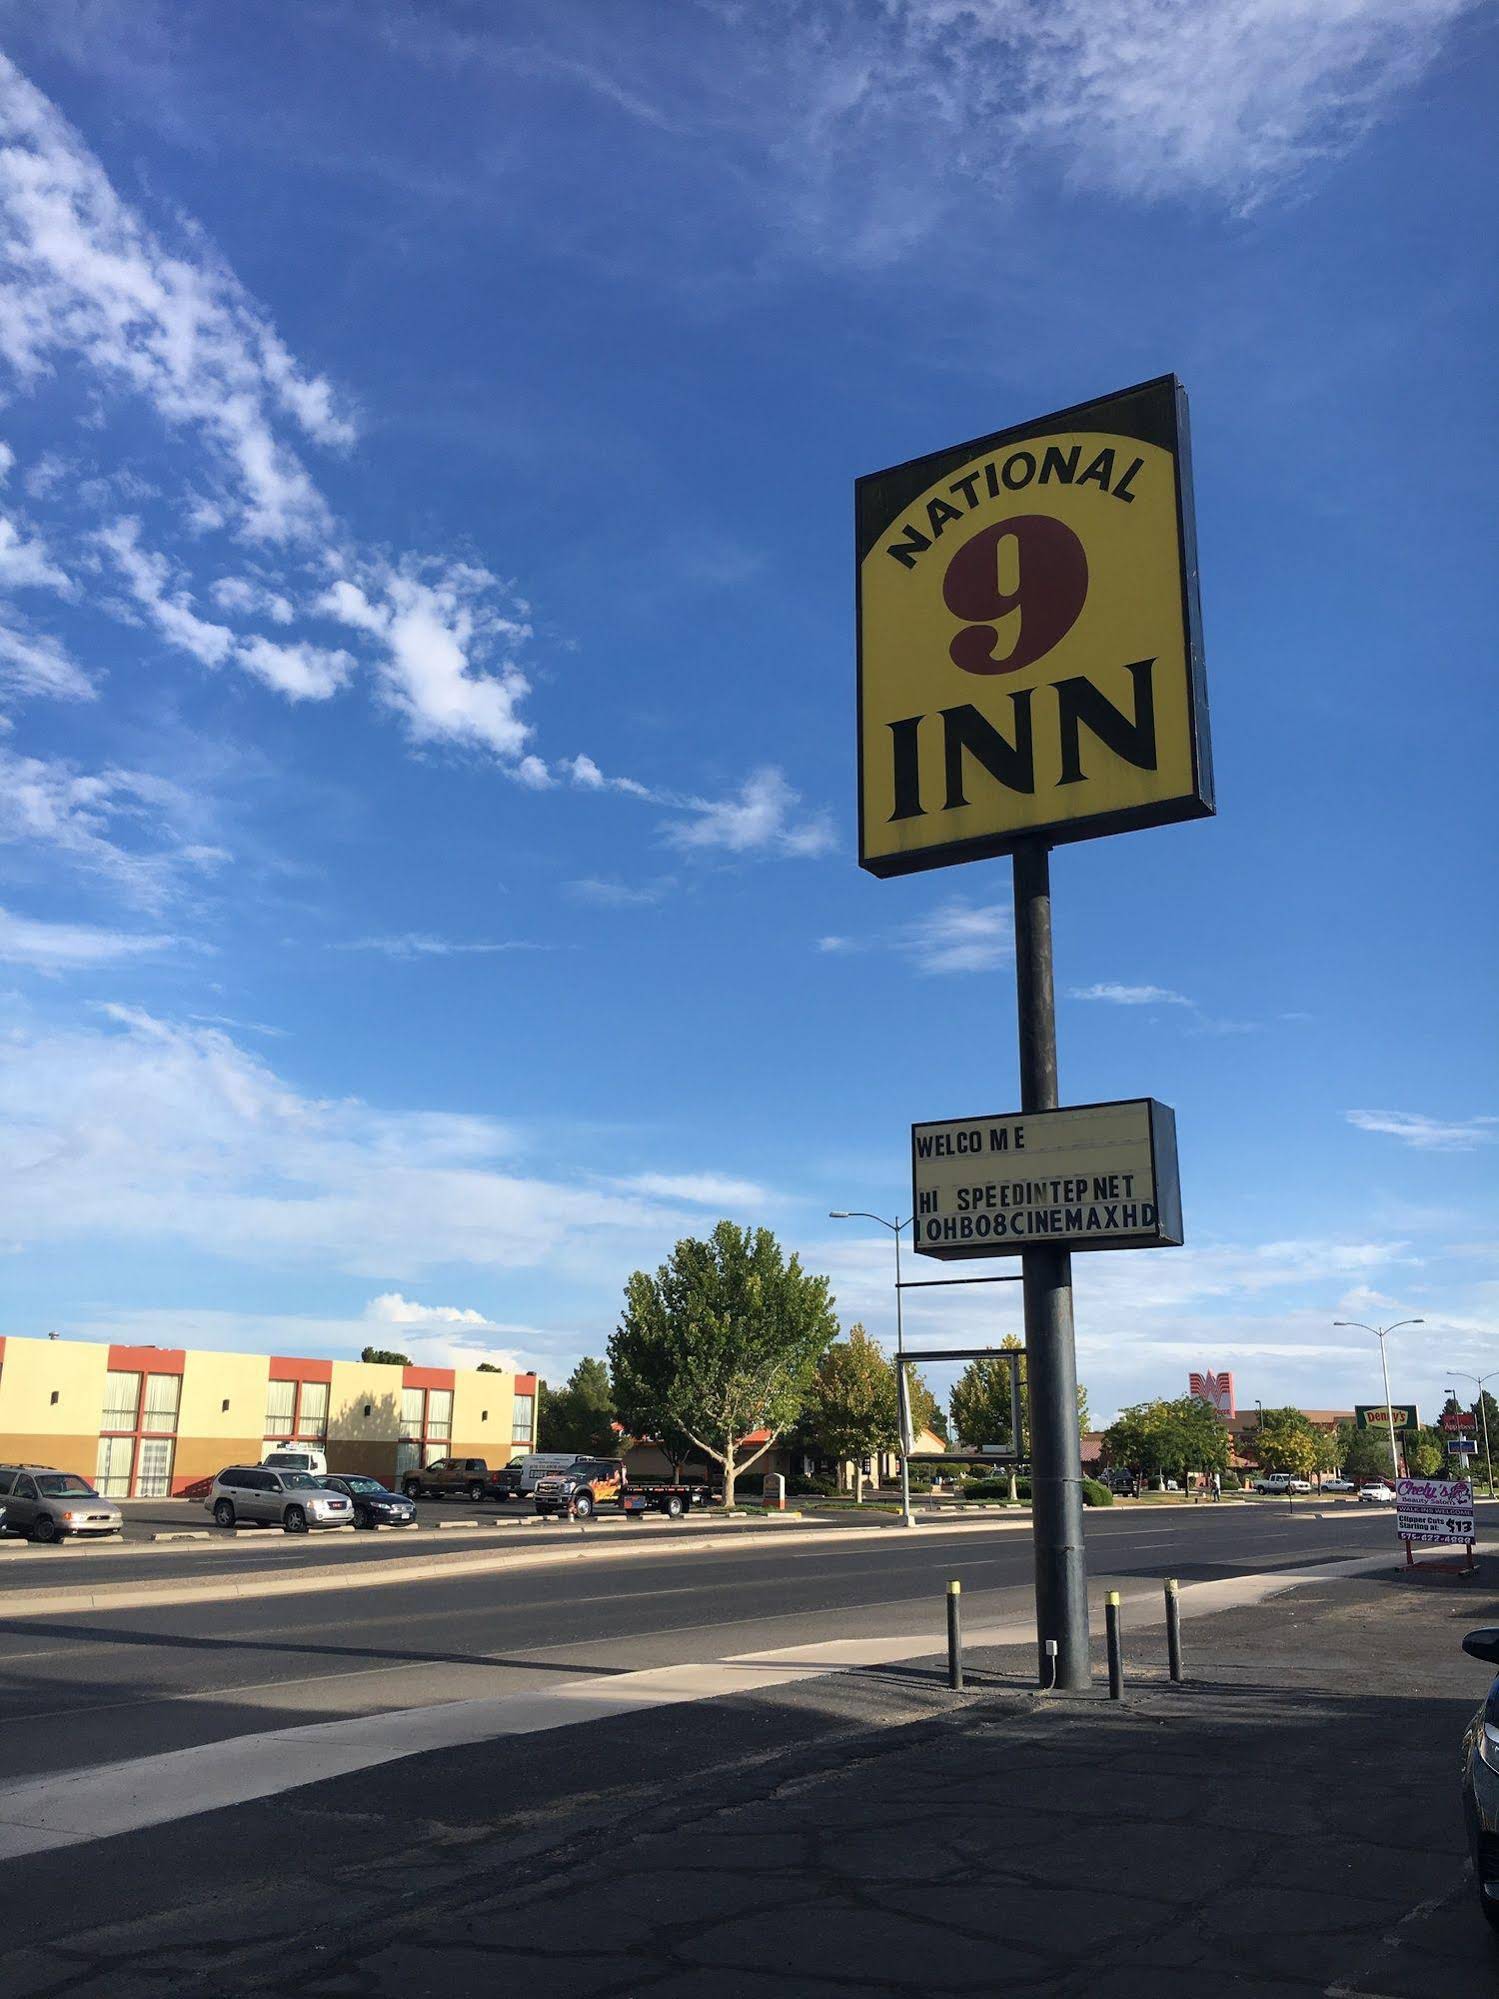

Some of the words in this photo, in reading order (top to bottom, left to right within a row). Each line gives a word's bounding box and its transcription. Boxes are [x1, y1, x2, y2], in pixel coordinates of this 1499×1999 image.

[886, 446, 1145, 569] NATIONAL
[942, 514, 1089, 675] 9
[885, 657, 1157, 823] INN
[920, 1190, 938, 1213] HI
[1367, 1411, 1406, 1423] Deny's
[1446, 1518, 1472, 1533] $13
